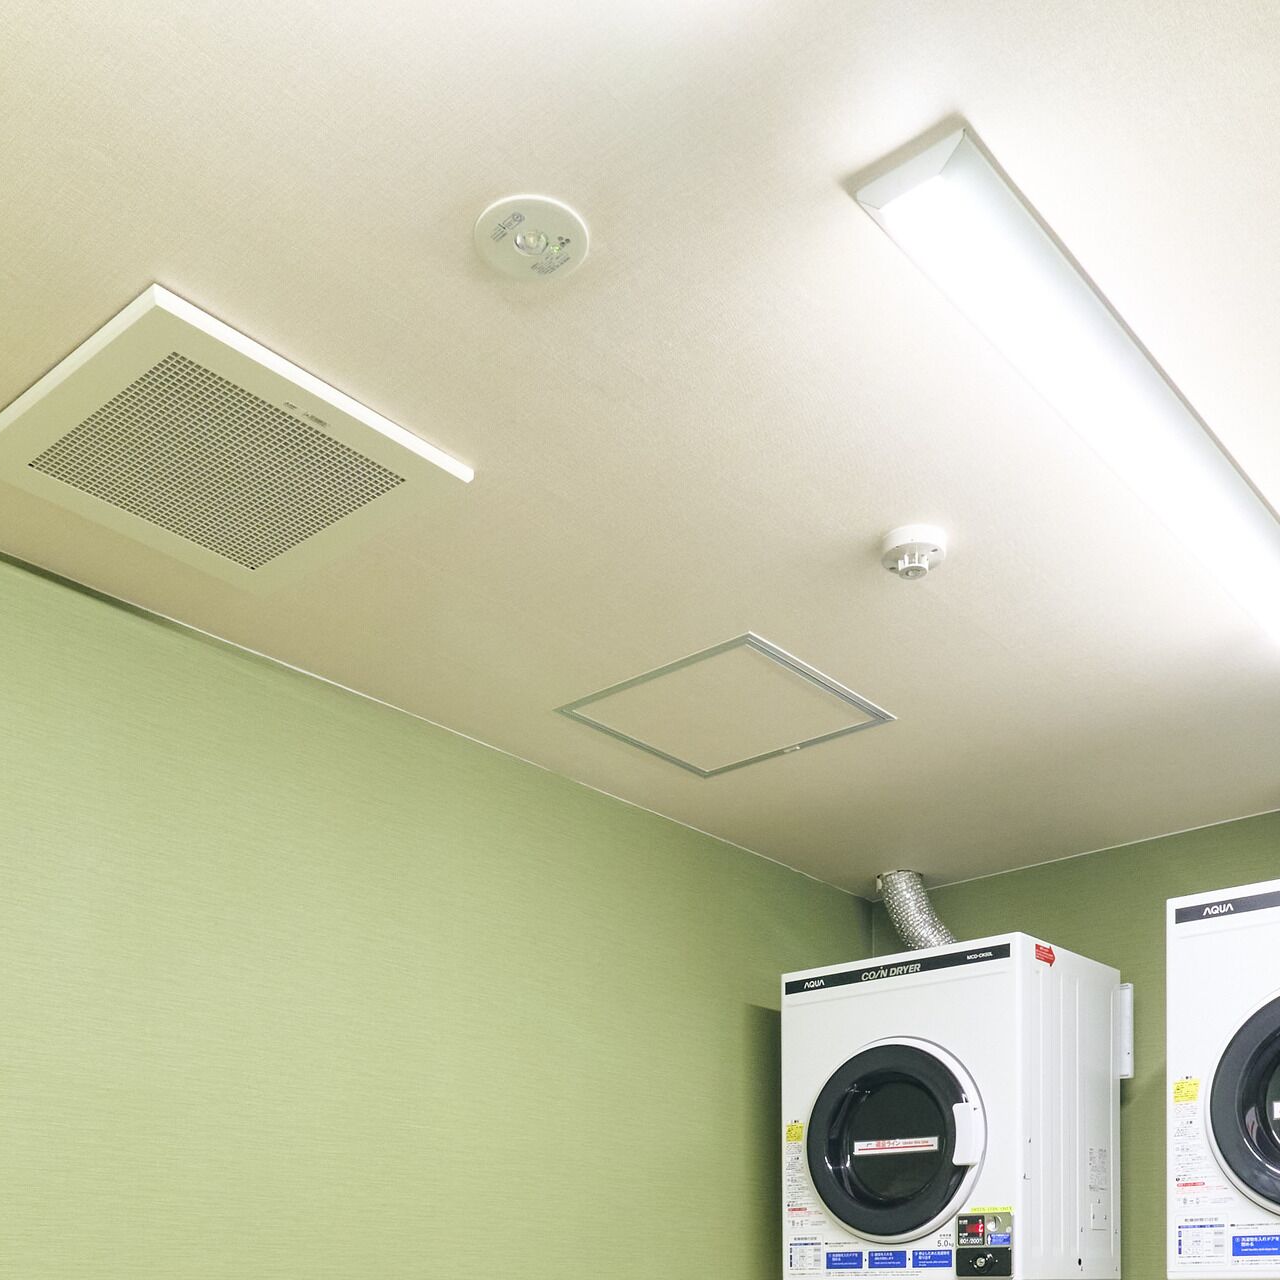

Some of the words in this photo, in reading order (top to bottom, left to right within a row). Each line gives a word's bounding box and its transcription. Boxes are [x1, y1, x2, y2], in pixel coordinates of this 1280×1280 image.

[1203, 903, 1233, 916] AQUA
[861, 966, 888, 981] COIN
[889, 963, 921, 977] DRYER
[804, 979, 825, 989] AQUA
